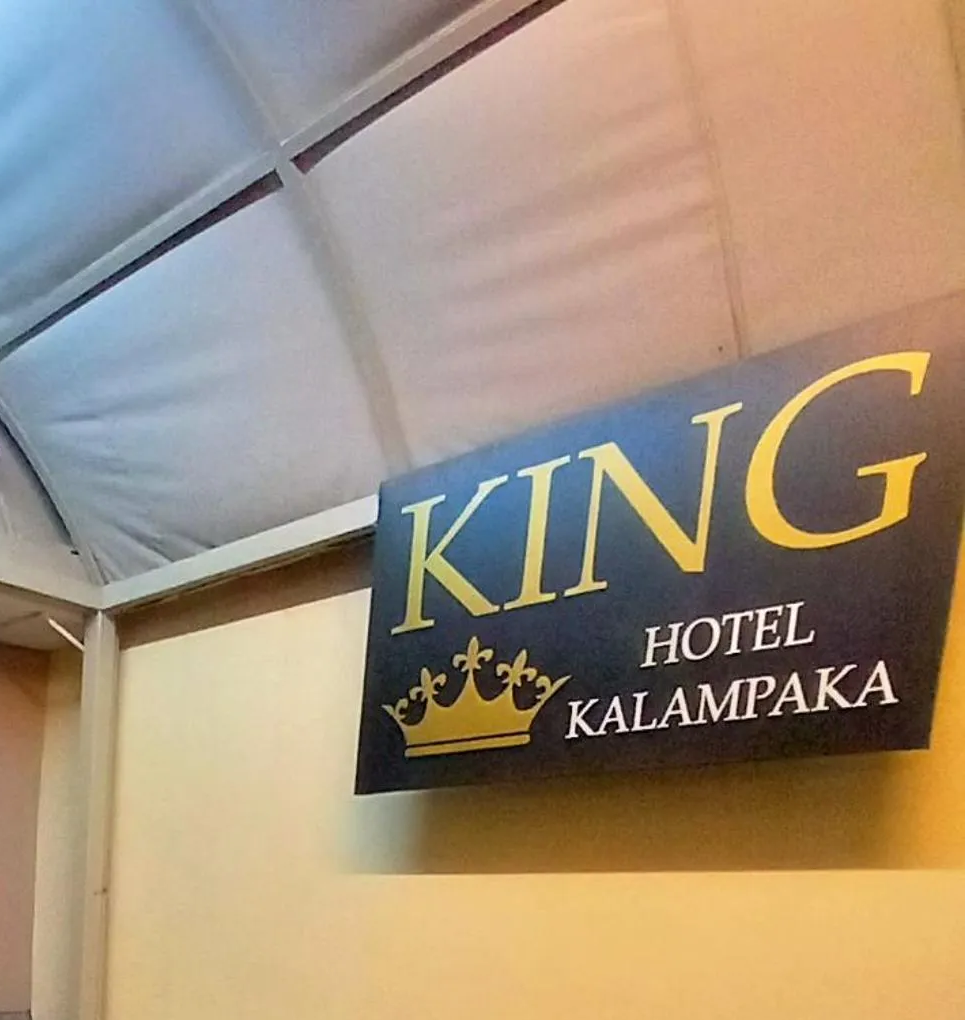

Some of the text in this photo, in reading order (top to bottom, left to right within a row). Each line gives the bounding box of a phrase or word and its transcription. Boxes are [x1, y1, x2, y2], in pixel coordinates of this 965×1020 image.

[390, 352, 931, 636] KING
[639, 601, 815, 669] HOTEL
[564, 660, 899, 740] KALAMPAKA
